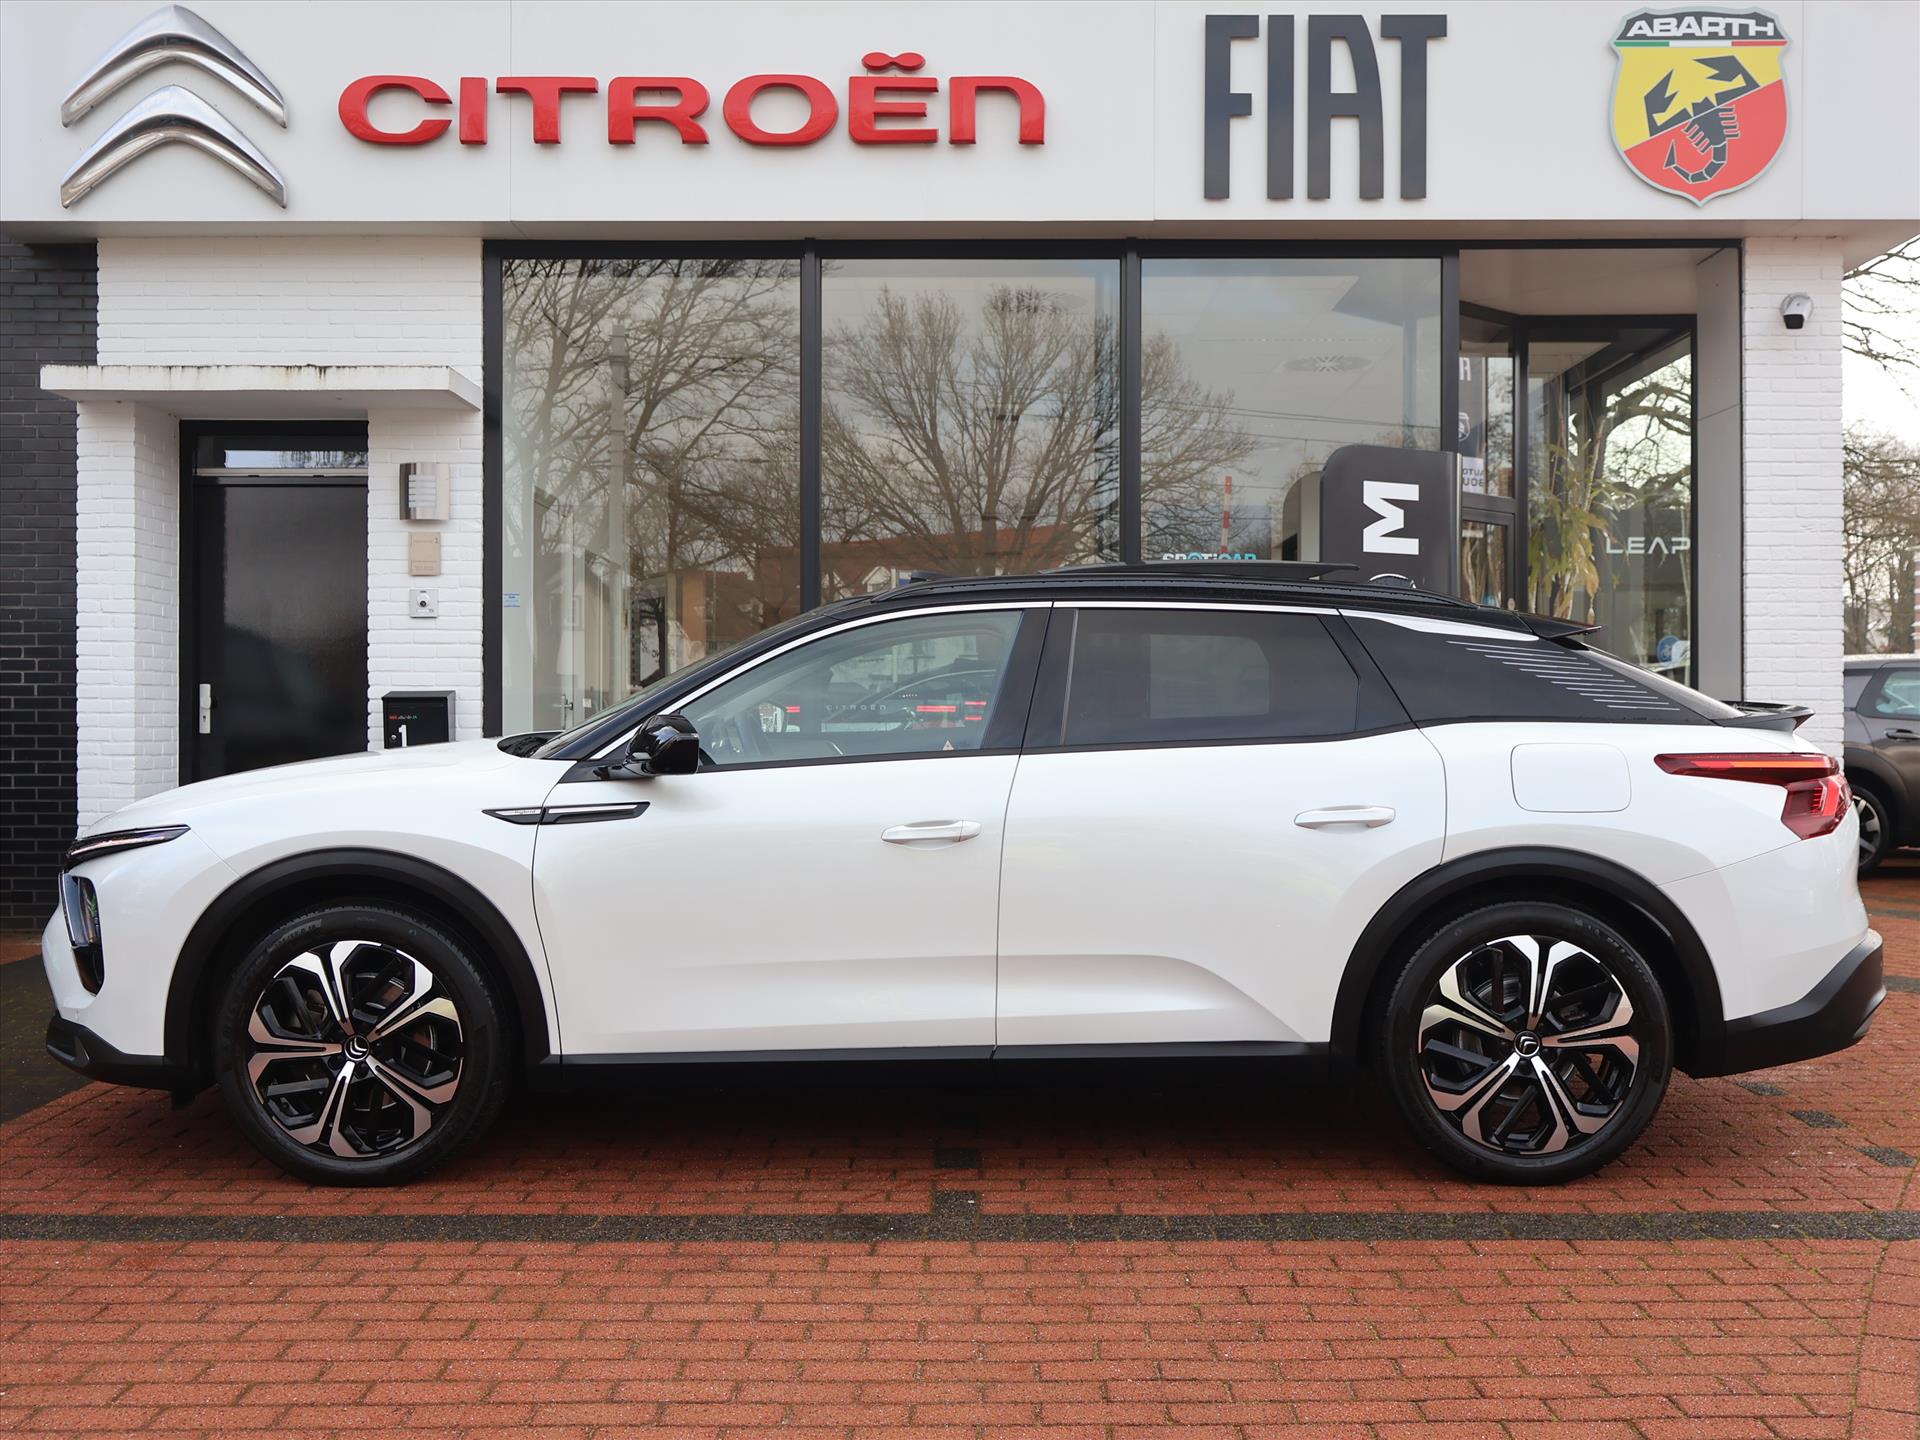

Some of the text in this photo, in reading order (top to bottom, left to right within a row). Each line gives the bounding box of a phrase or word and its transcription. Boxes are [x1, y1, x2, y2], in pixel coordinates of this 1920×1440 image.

[1627, 16, 1775, 37] ABARTH
[338, 52, 1046, 146] CITROËN
[1203, 14, 1448, 201] FIAT
[1606, 536, 1691, 554] LEAP
[398, 724, 408, 748] 1
